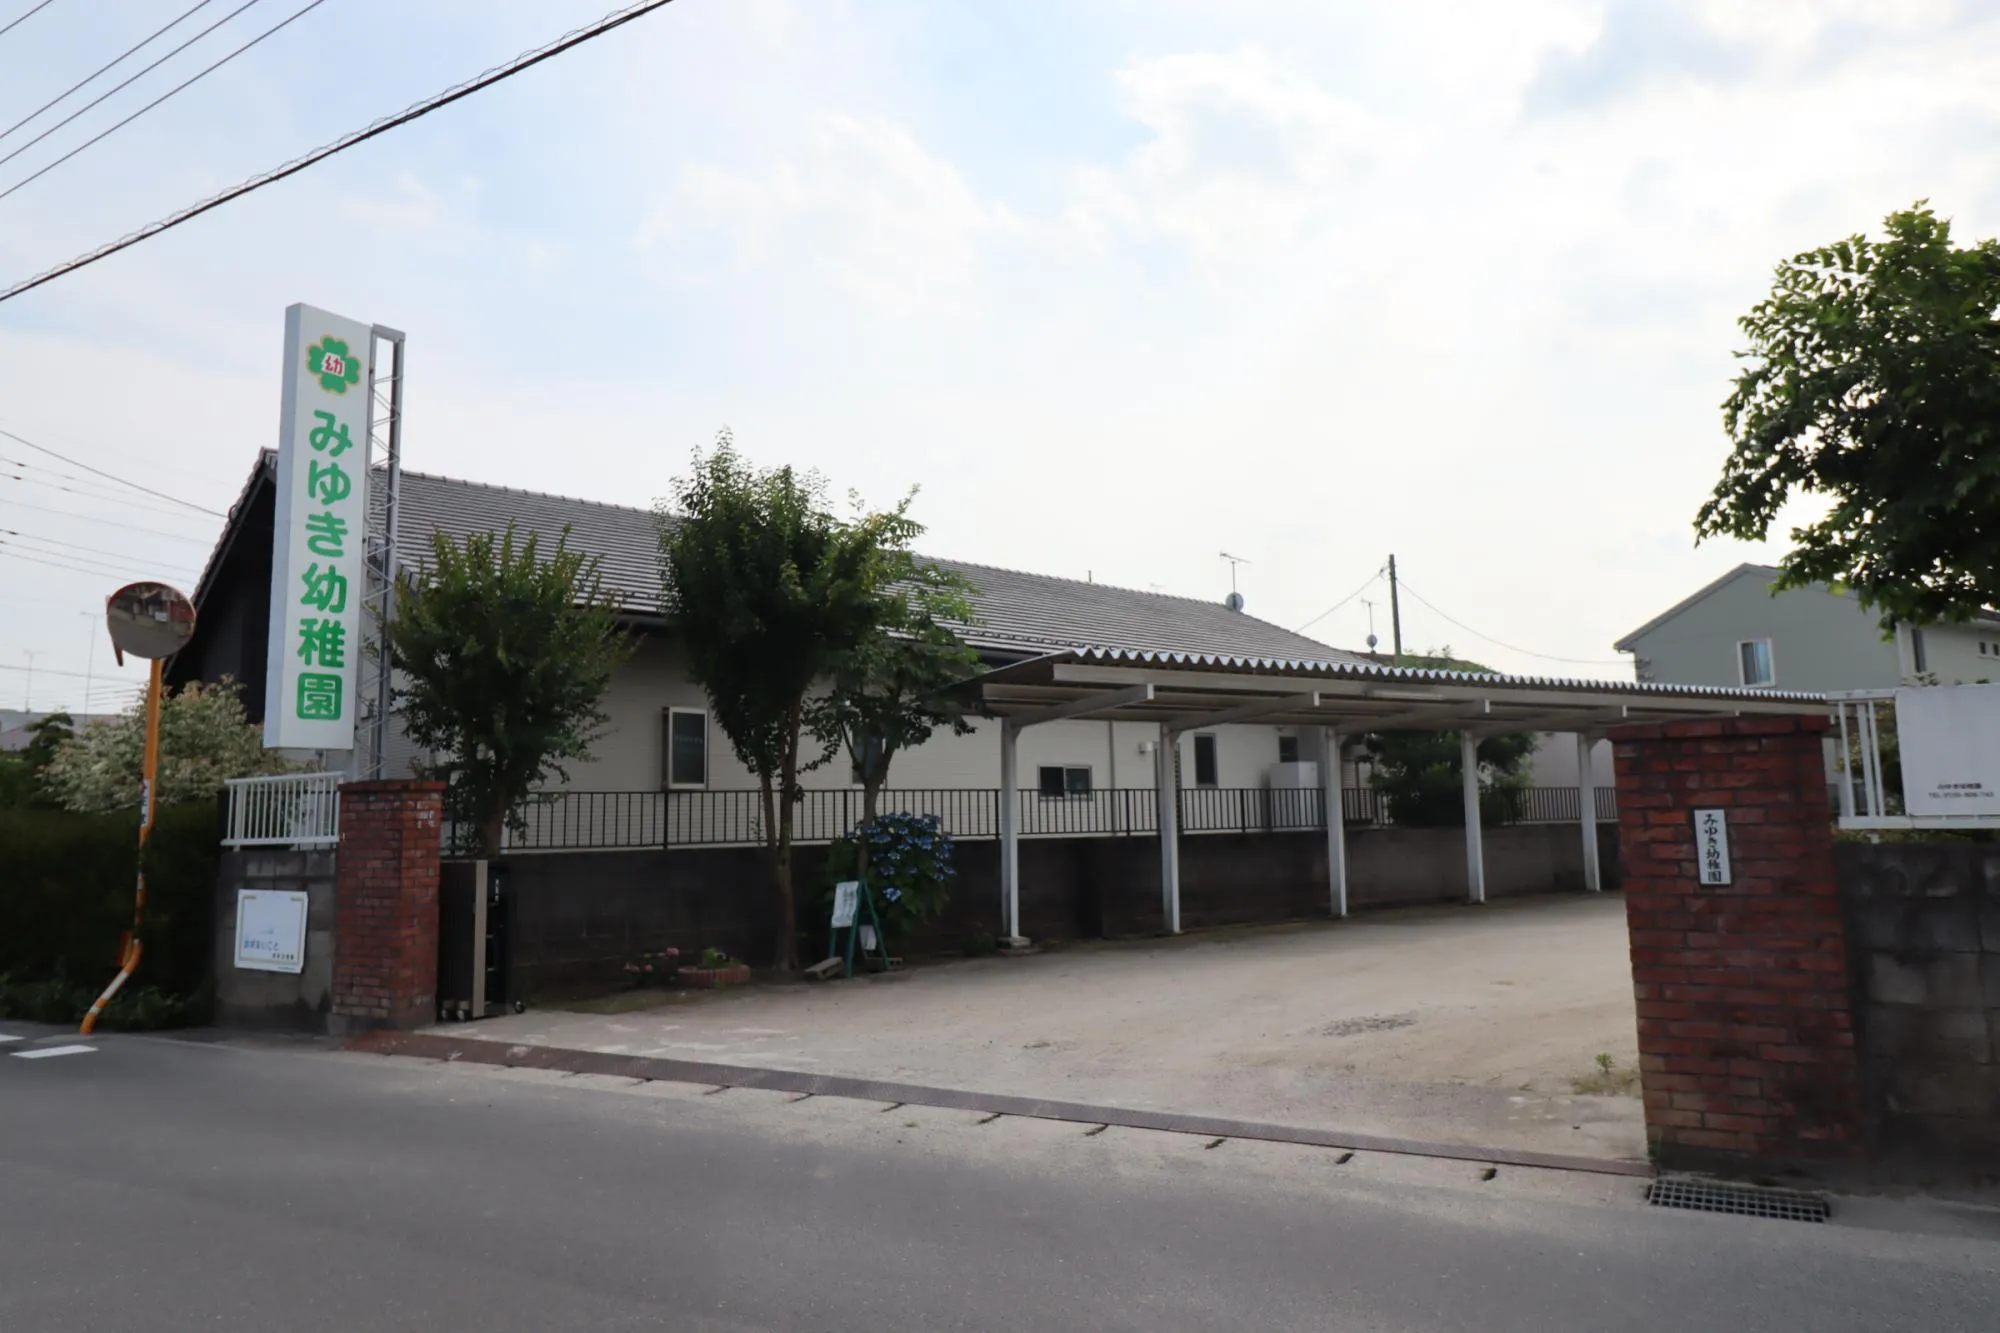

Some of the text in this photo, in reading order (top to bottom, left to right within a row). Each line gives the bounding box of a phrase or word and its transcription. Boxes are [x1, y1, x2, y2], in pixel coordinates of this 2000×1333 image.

[325, 354, 343, 375] 幼
[297, 409, 353, 719] みゆき幼稚園
